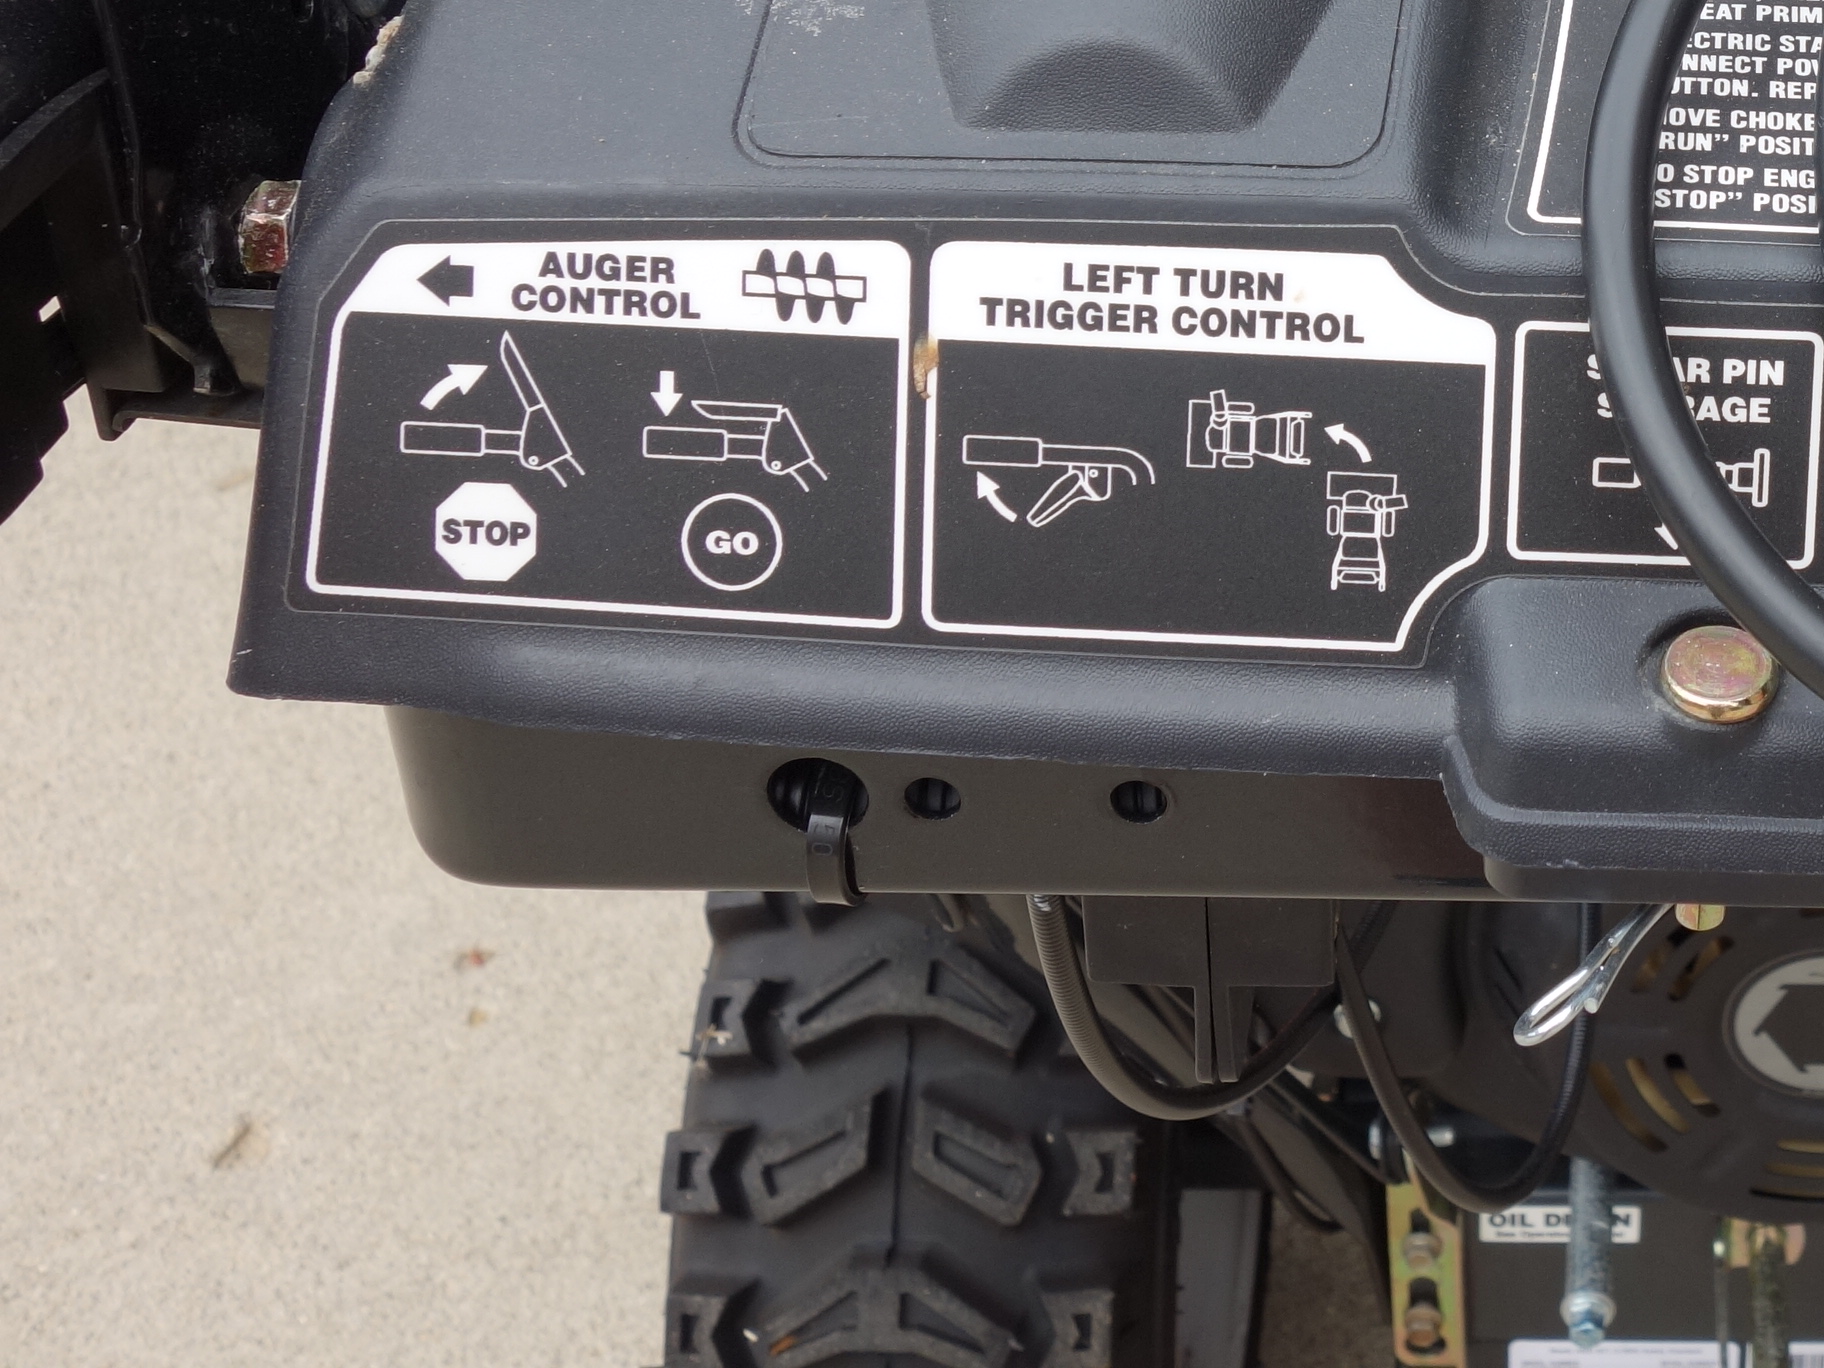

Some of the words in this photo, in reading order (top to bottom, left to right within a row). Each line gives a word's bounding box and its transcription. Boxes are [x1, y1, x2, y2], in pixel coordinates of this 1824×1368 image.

[1700, 3, 1747, 22] EAT
[1684, 30, 1772, 52] CTRIC
[1778, 33, 1824, 54] STA
[1681, 53, 1768, 75] NNECT
[1670, 76, 1759, 98] UTTON.
[1768, 80, 1817, 100] REP
[1664, 106, 1721, 128] OVE
[1729, 109, 1816, 132] CHOKE
[1658, 131, 1730, 152] RUN”
[1738, 134, 1816, 156] POSIT
[1656, 163, 1675, 183] O
[1682, 164, 1755, 186] STOP
[1762, 168, 1816, 189] ENG
[1653, 188, 1744, 210] STOP”
[1752, 192, 1817, 214] POSI
[537, 251, 676, 284] AUGER
[1062, 262, 1161, 296] LEFT
[1173, 266, 1285, 302] TURN
[511, 284, 701, 321] CONTROL
[979, 296, 1159, 335] TRIGGER
[1171, 306, 1365, 344] CONTROL
[1722, 357, 1785, 386] PIN
[440, 517, 532, 548] STOP
[705, 530, 760, 556] GO
[1488, 1212, 1535, 1229] OIL
